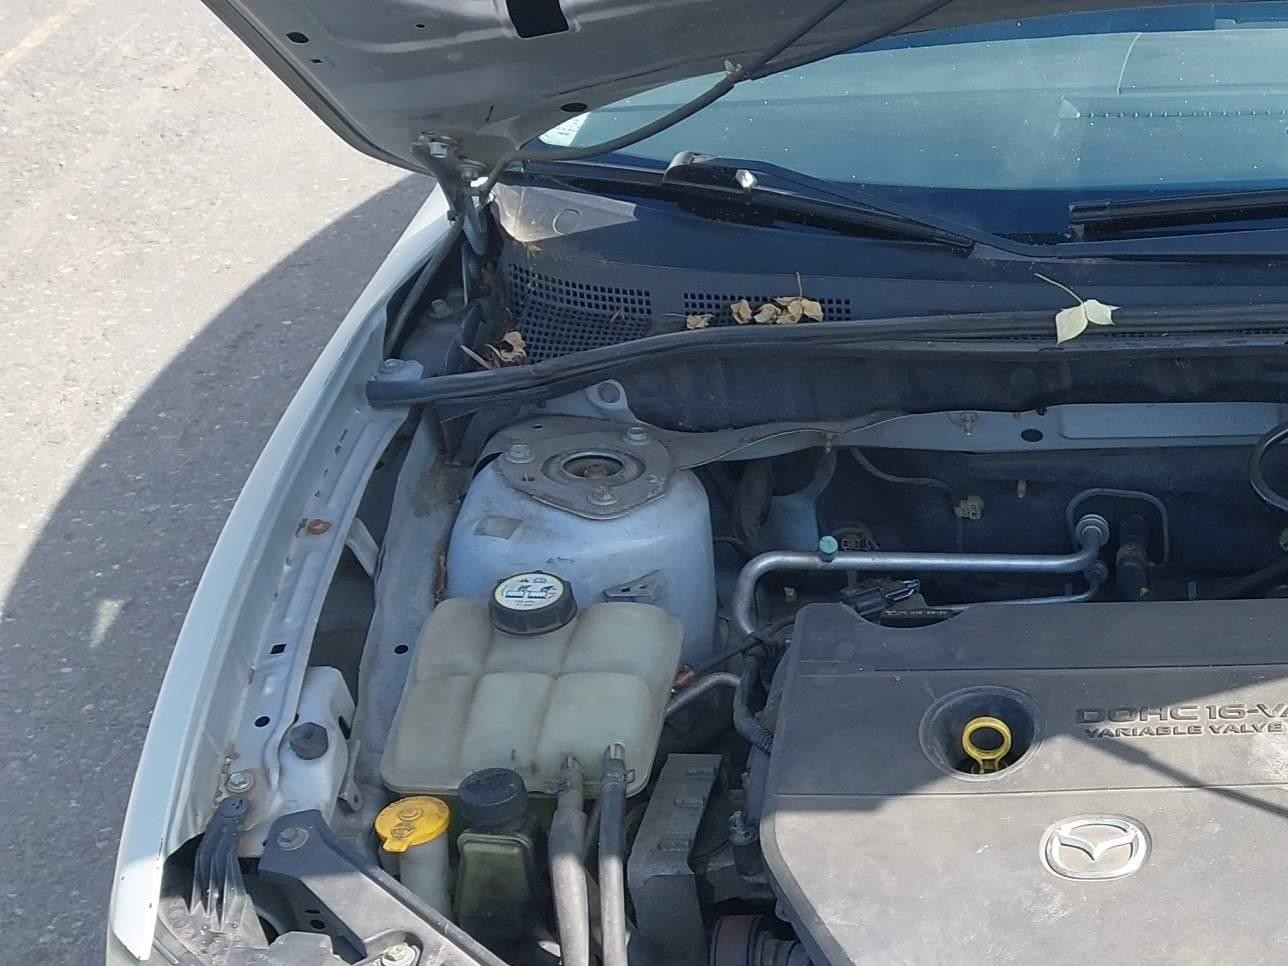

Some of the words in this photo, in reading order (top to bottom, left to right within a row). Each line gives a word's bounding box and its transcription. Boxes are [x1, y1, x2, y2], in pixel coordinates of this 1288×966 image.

[1076, 704, 1199, 724] DOHC
[1083, 724, 1203, 738] VARIABLE
[1208, 721, 1284, 735] VALVE
